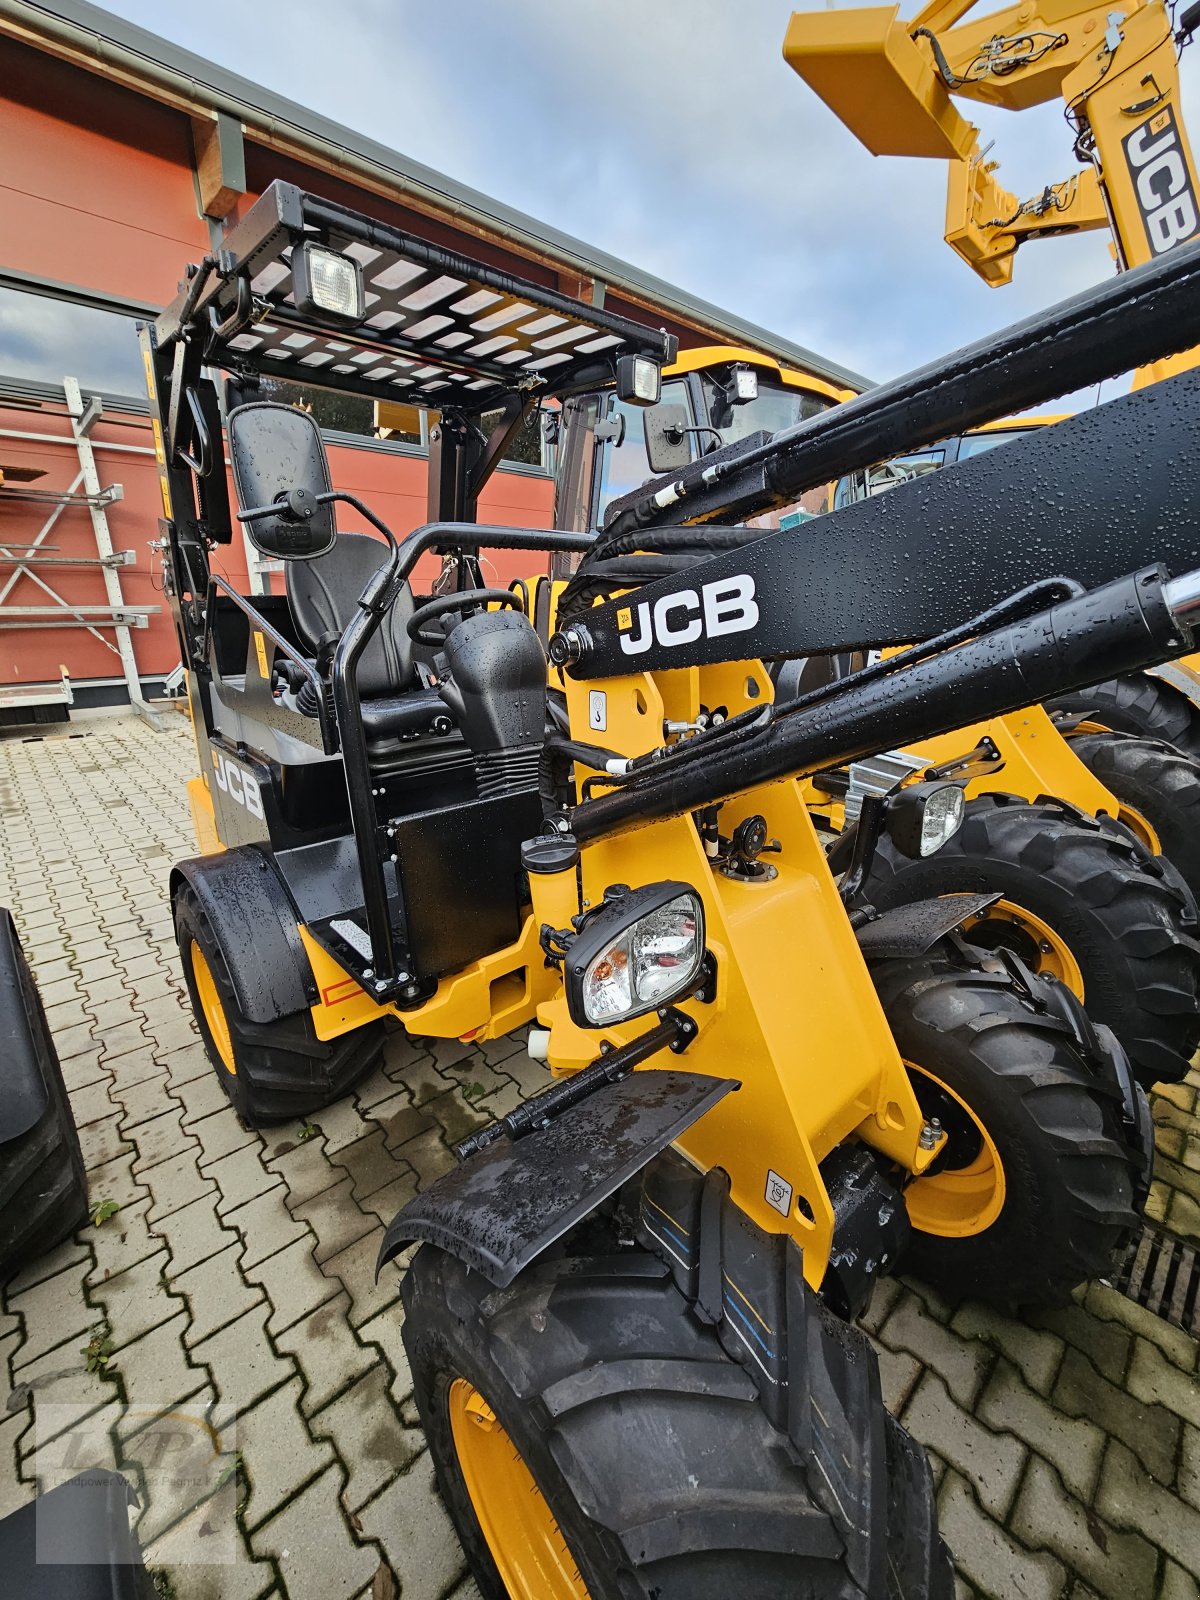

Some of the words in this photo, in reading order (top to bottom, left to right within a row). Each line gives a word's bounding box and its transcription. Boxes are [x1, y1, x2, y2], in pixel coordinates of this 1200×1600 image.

[1127, 126, 1197, 253] JCB
[620, 574, 760, 655] JCB
[215, 754, 264, 820] JCB
